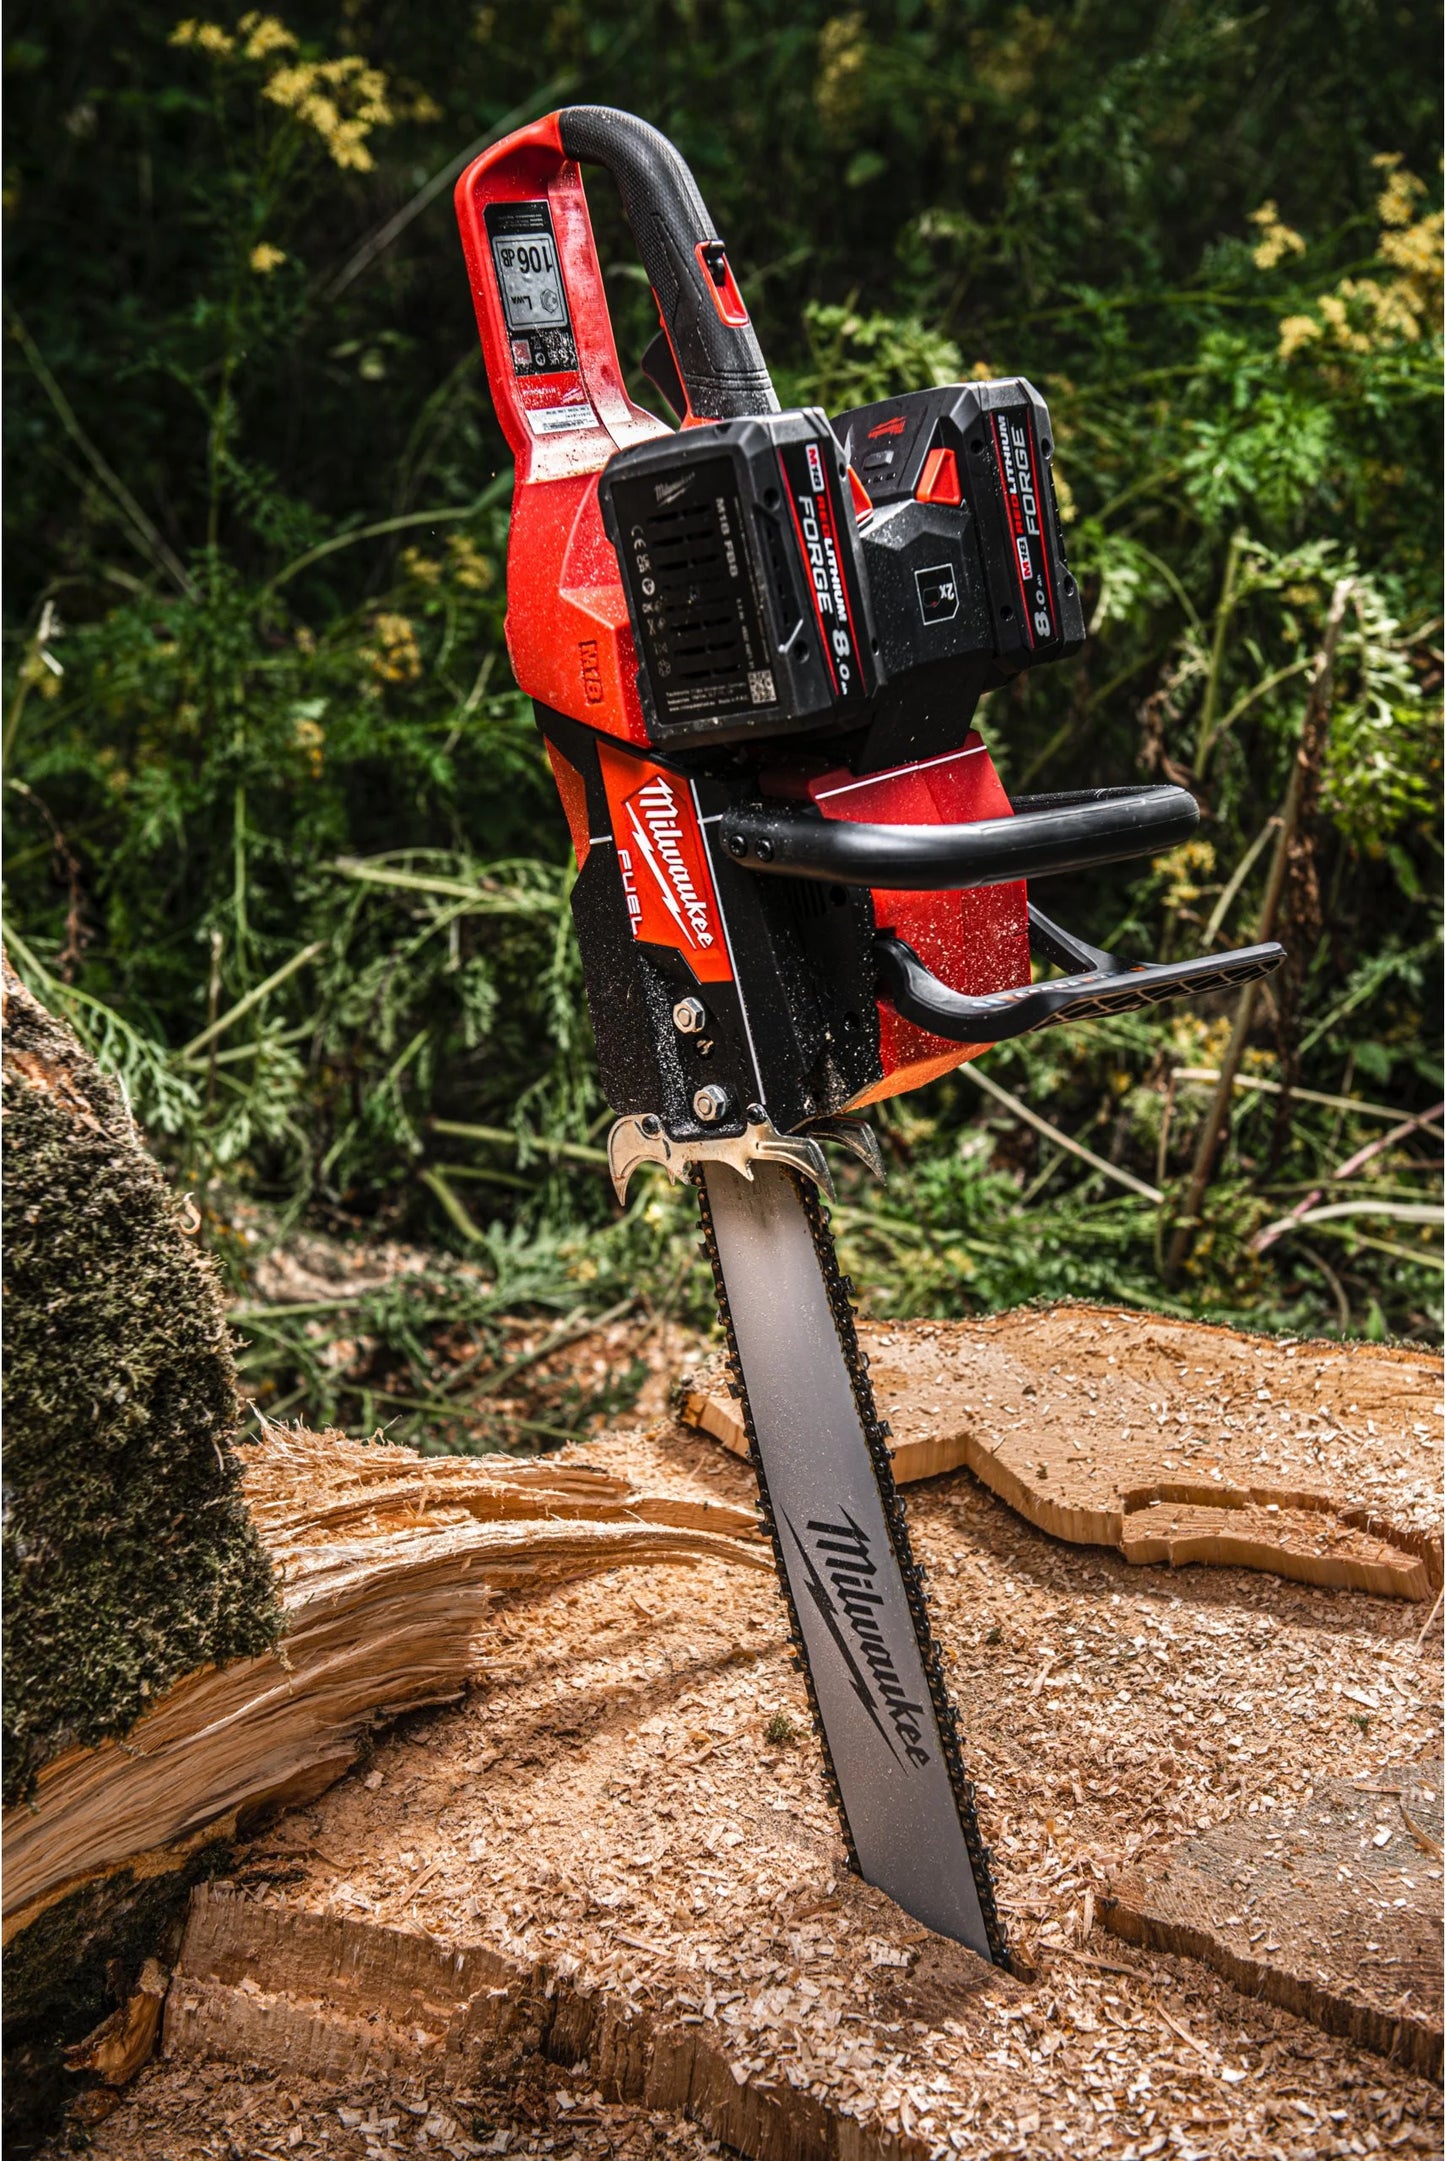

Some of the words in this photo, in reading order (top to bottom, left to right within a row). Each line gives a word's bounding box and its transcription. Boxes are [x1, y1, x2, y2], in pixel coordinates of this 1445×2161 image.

[500, 248, 515, 268] dB
[517, 246, 553, 274] 106
[806, 446, 824, 489] M18
[998, 415, 1026, 535] REDLITHIUM
[1011, 426, 1041, 536] FORGE
[799, 495, 834, 615] FORGE
[816, 494, 848, 622] REDLITHIUM
[1018, 539, 1032, 578] M18
[832, 629, 850, 681] 8.0
[1034, 588, 1051, 637] 8.0
[617, 848, 643, 936] FUEL
[638, 775, 716, 950] Milwaukee
[805, 1504, 931, 1770] Milwaukee
